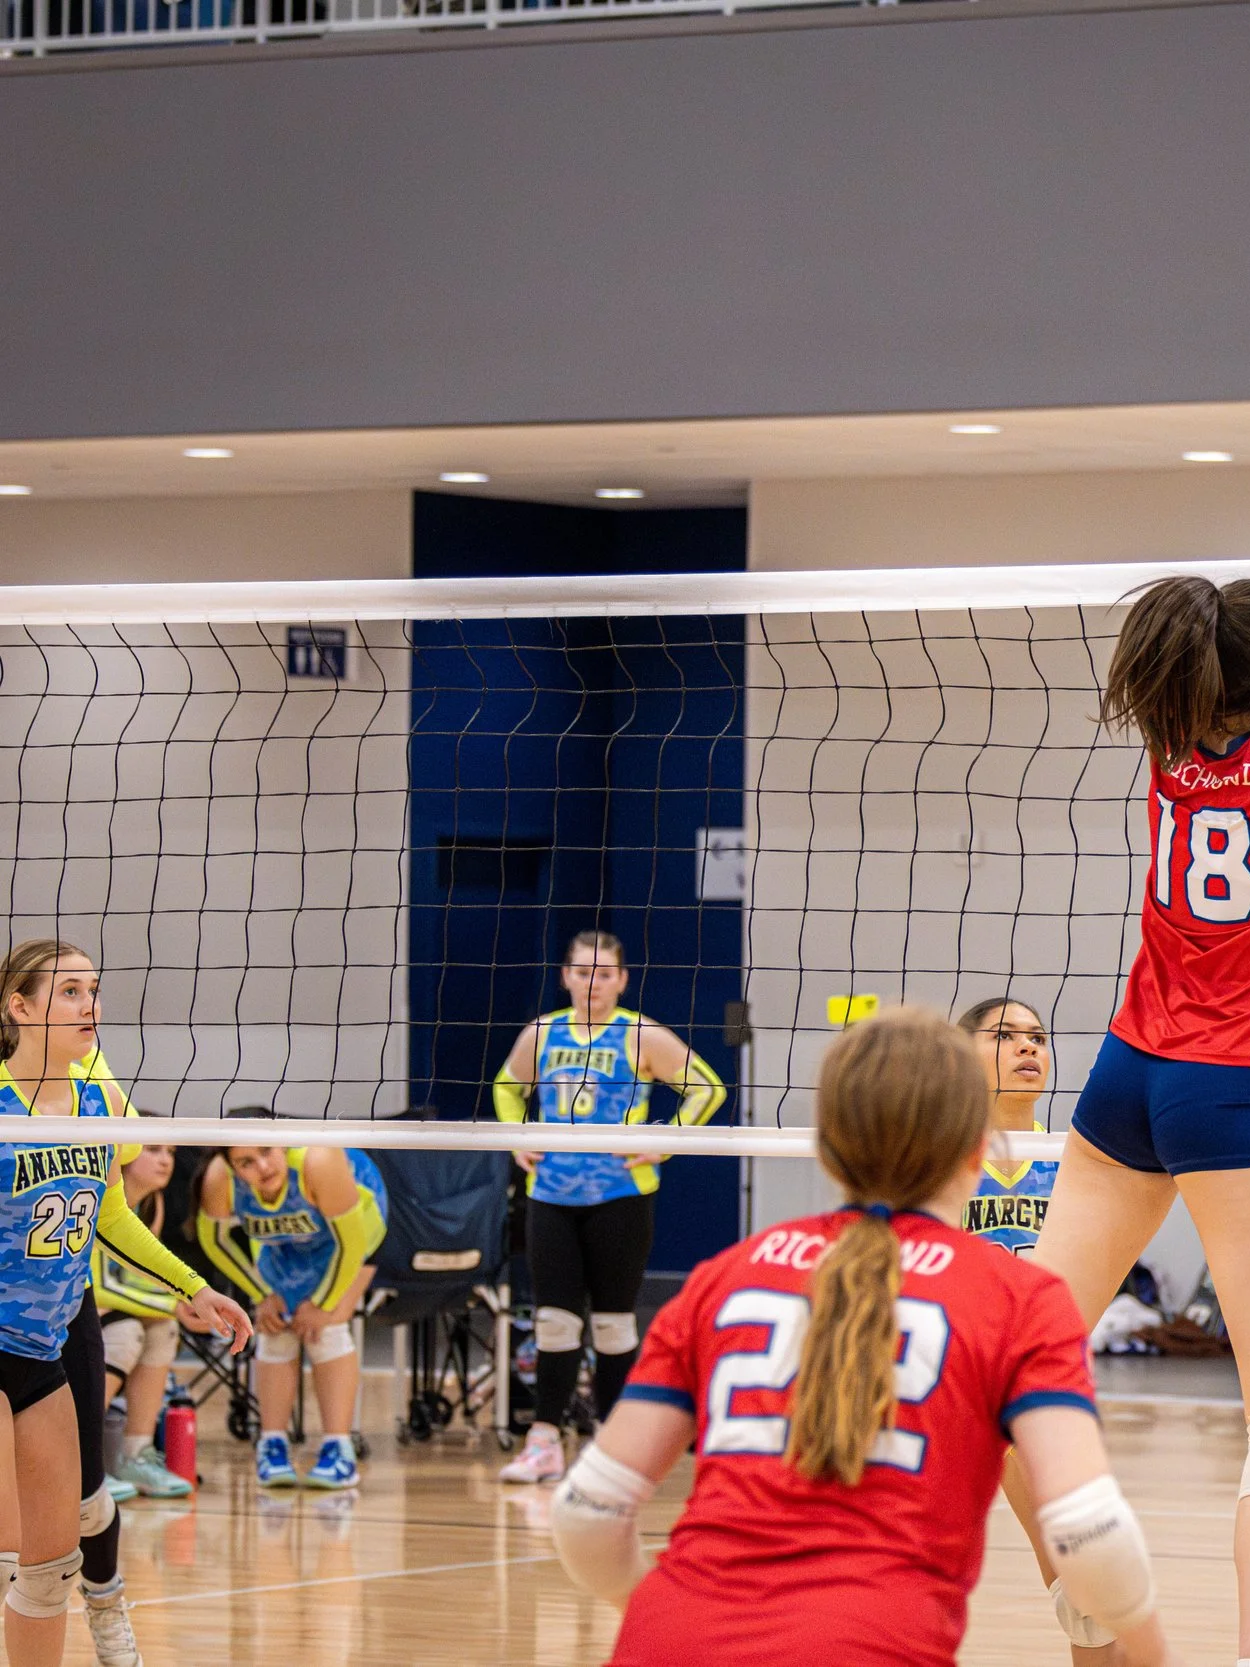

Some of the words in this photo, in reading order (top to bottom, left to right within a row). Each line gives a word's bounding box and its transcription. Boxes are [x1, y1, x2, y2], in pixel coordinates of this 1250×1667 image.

[15, 1145, 107, 1193] ANARCHY
[25, 1188, 98, 1260] 23
[962, 1197, 1049, 1233] NARCH
[751, 1230, 954, 1276] RICND
[703, 1286, 950, 1475] 22
